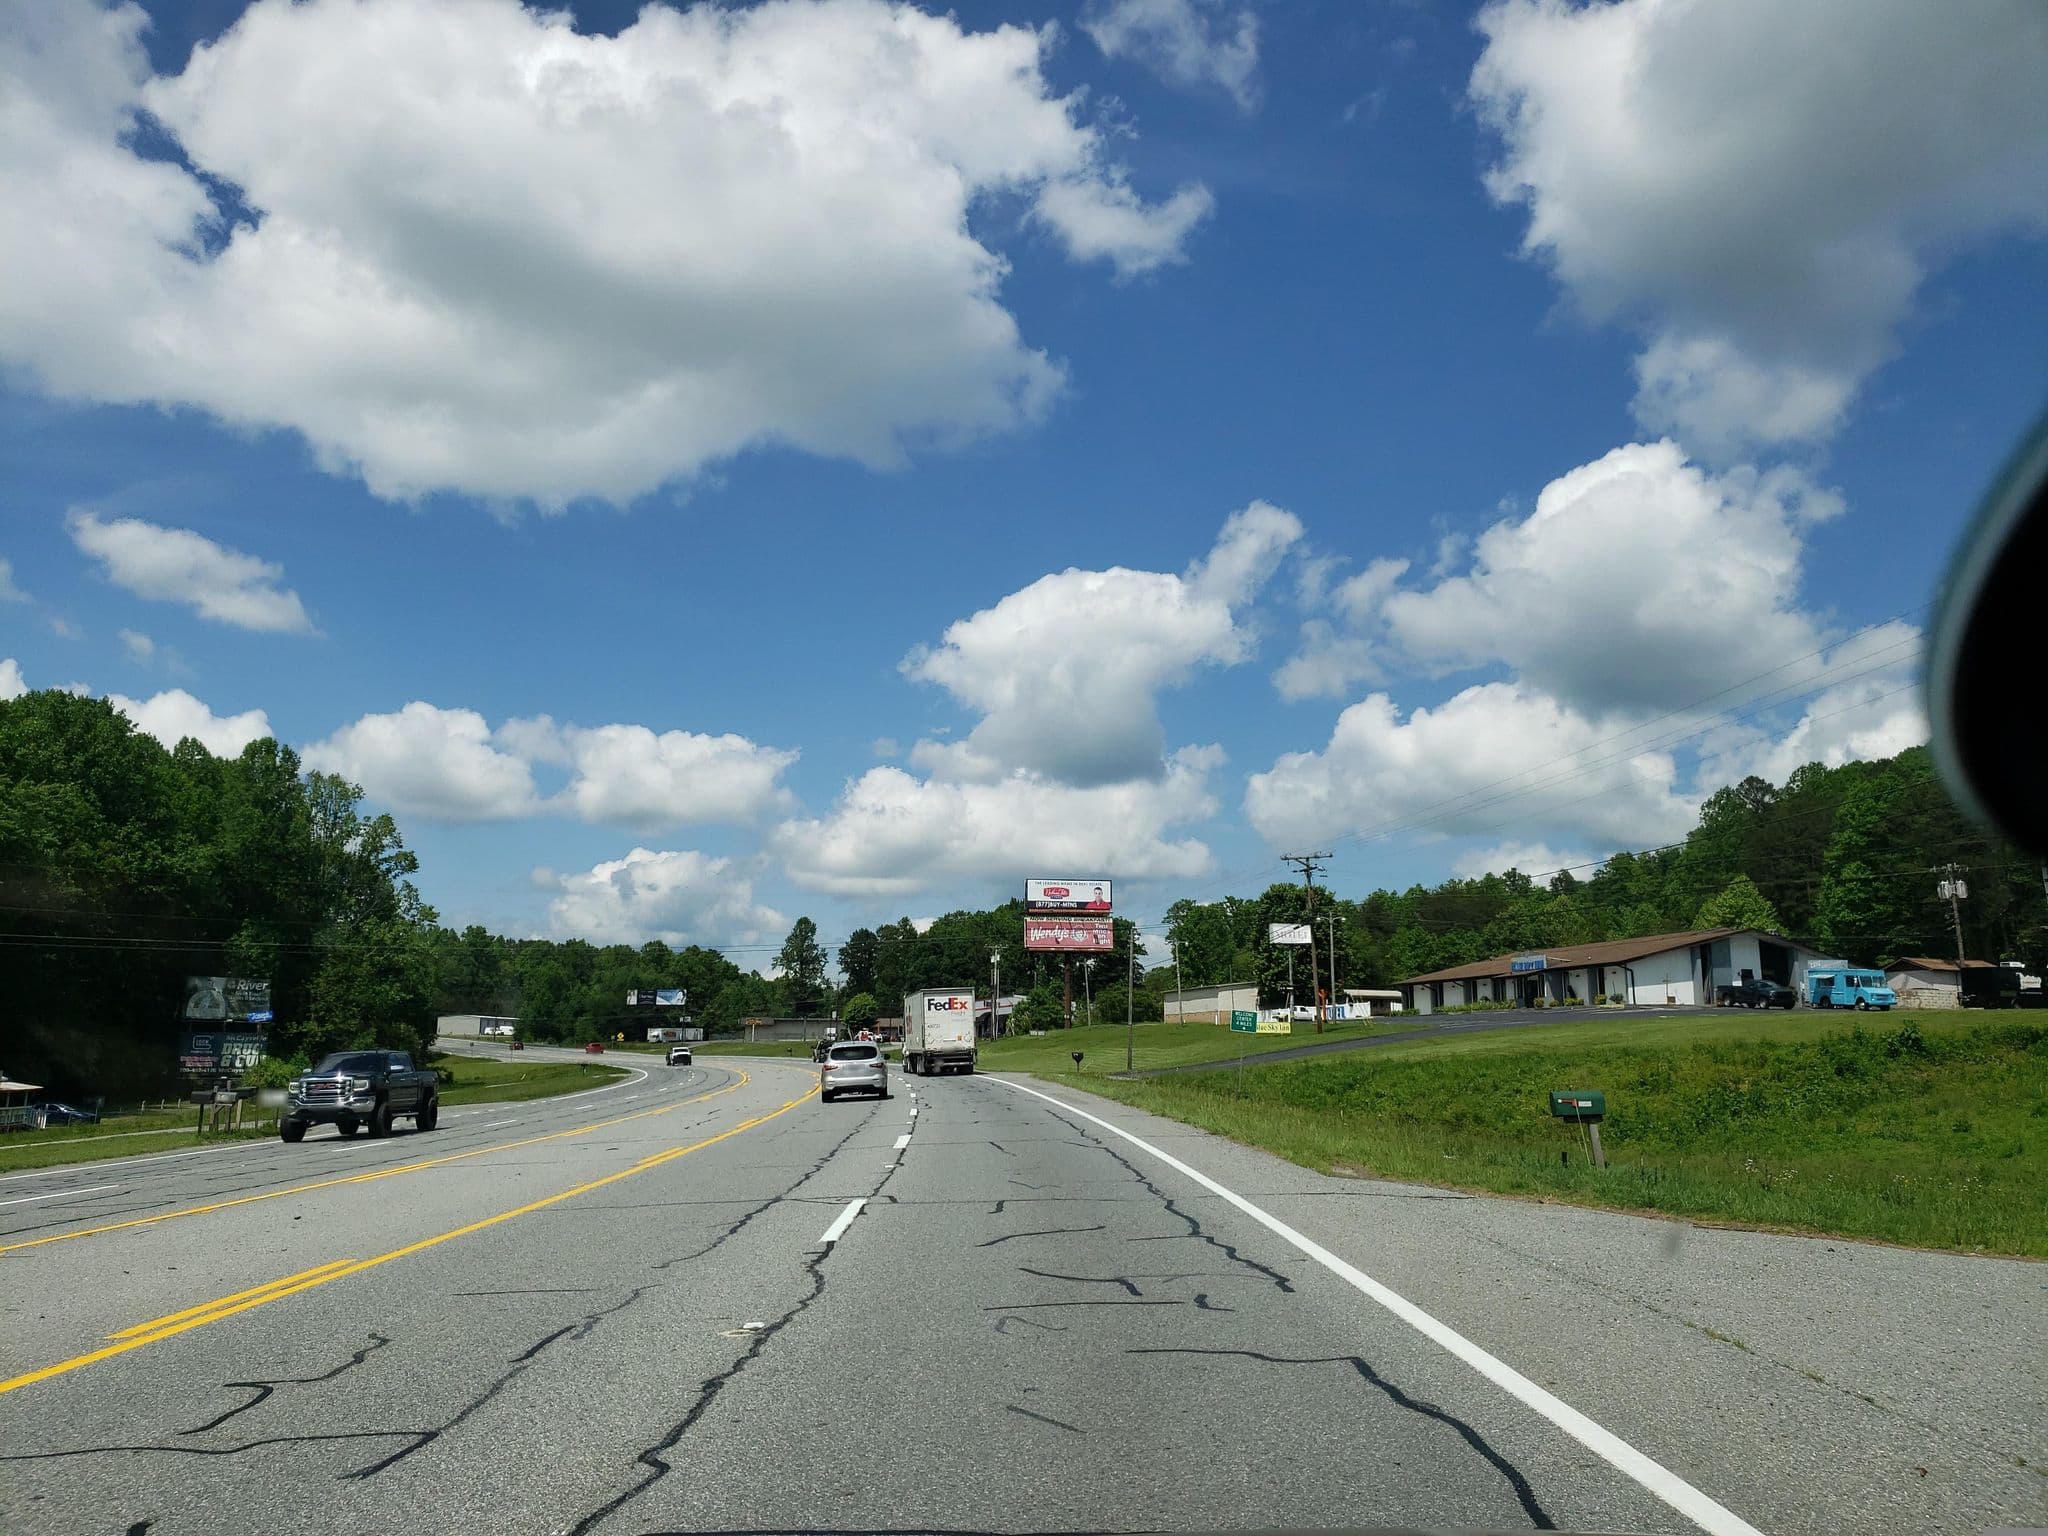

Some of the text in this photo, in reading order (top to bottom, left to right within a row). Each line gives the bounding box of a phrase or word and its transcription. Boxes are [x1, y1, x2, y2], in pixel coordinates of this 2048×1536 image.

[1030, 925, 1070, 942] Wendy's
[237, 980, 269, 991] River
[927, 998, 968, 1011] FedEx
